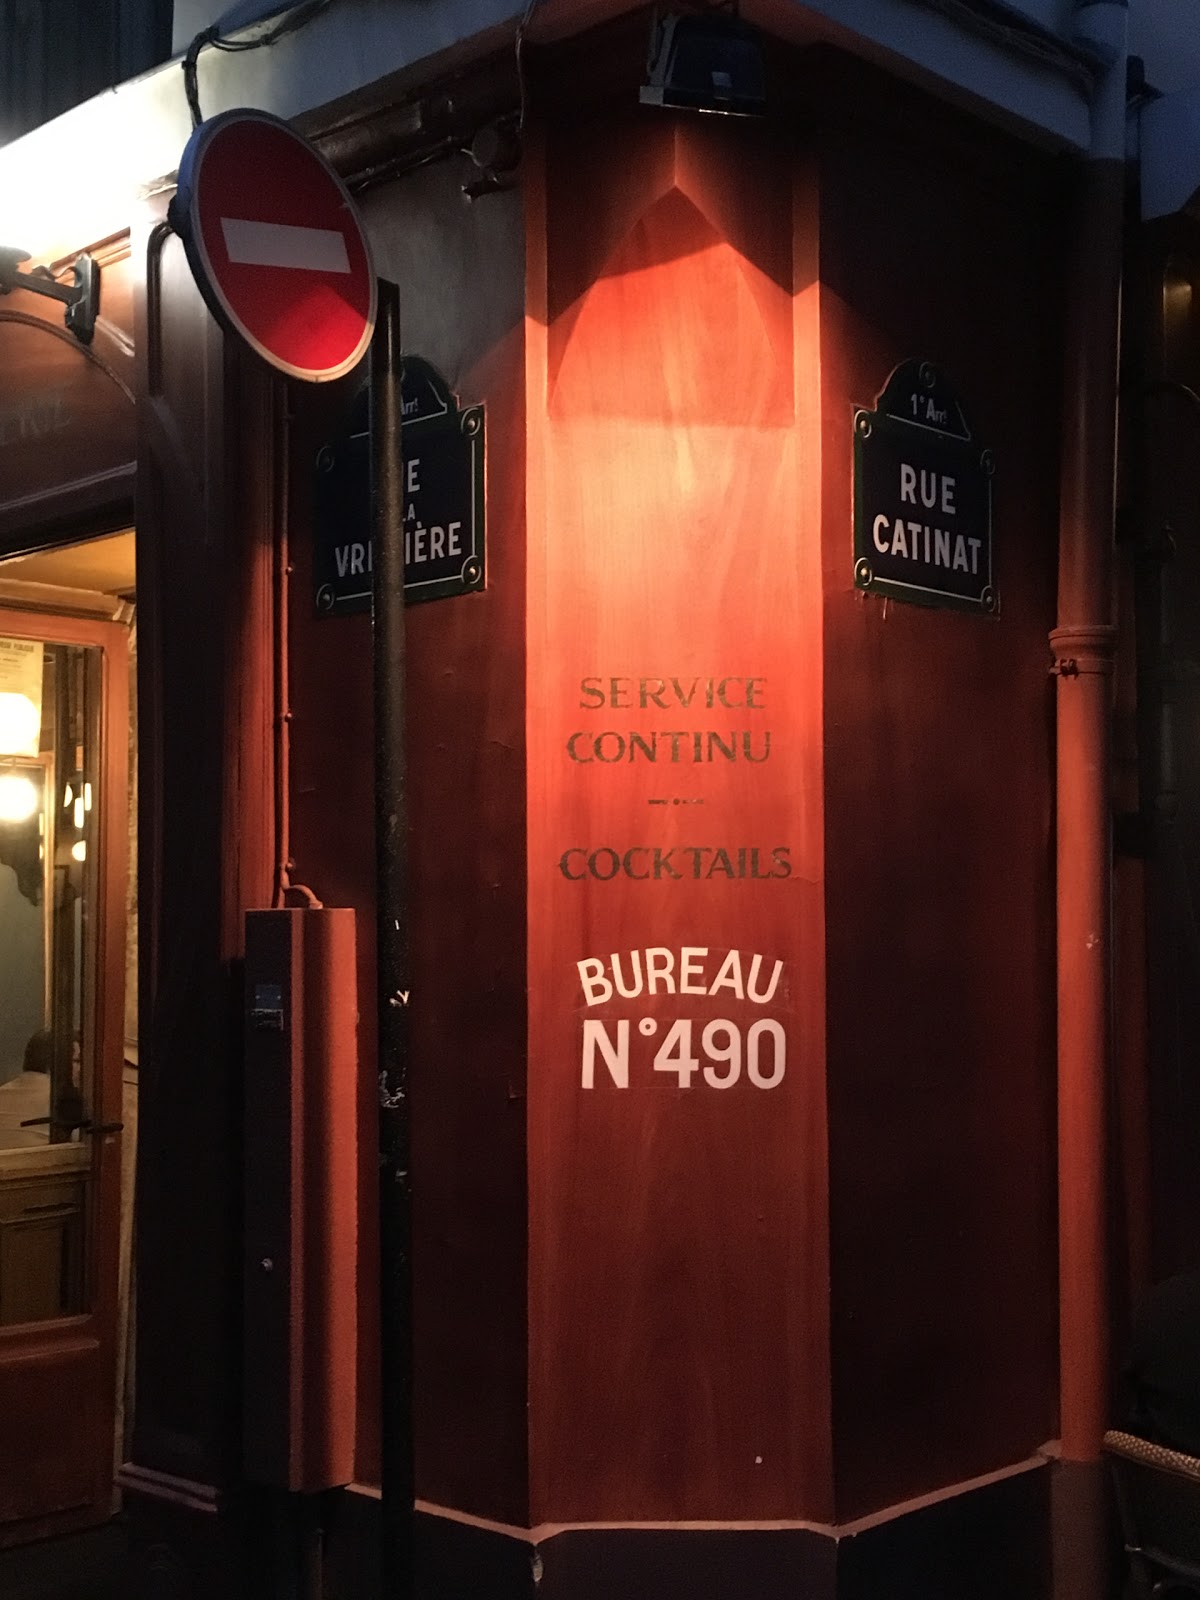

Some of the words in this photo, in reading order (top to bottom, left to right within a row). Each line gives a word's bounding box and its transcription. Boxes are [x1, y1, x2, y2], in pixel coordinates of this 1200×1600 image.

[900, 462, 956, 515] RUE
[335, 521, 462, 578] VRIIÈRE
[872, 513, 981, 575] CATINAT
[579, 677, 768, 709] SERVICE
[565, 731, 771, 763] CONTINU
[558, 846, 792, 880] COCKTAILS
[576, 947, 784, 1007] BUREAU
